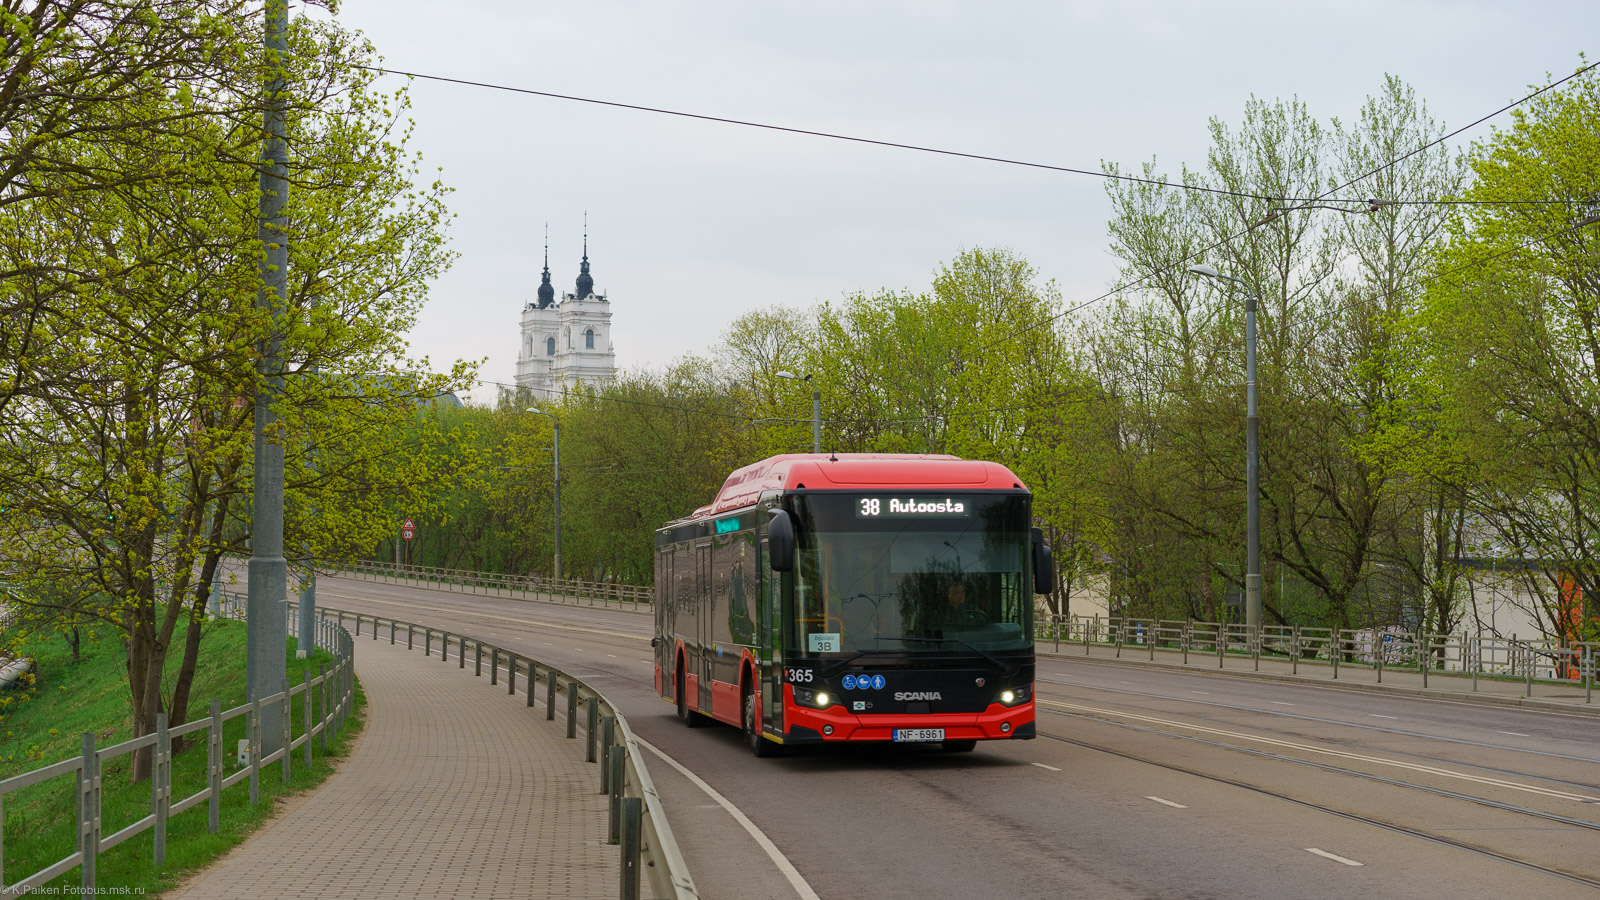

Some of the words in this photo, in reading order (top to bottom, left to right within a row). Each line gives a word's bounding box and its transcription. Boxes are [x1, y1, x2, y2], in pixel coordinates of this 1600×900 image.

[860, 498, 880, 515] 38
[889, 498, 964, 513] Autoosta
[817, 642, 832, 651] 3B
[789, 669, 814, 683] 365
[894, 691, 942, 701] SCANIA
[899, 730, 944, 739] NF-6961
